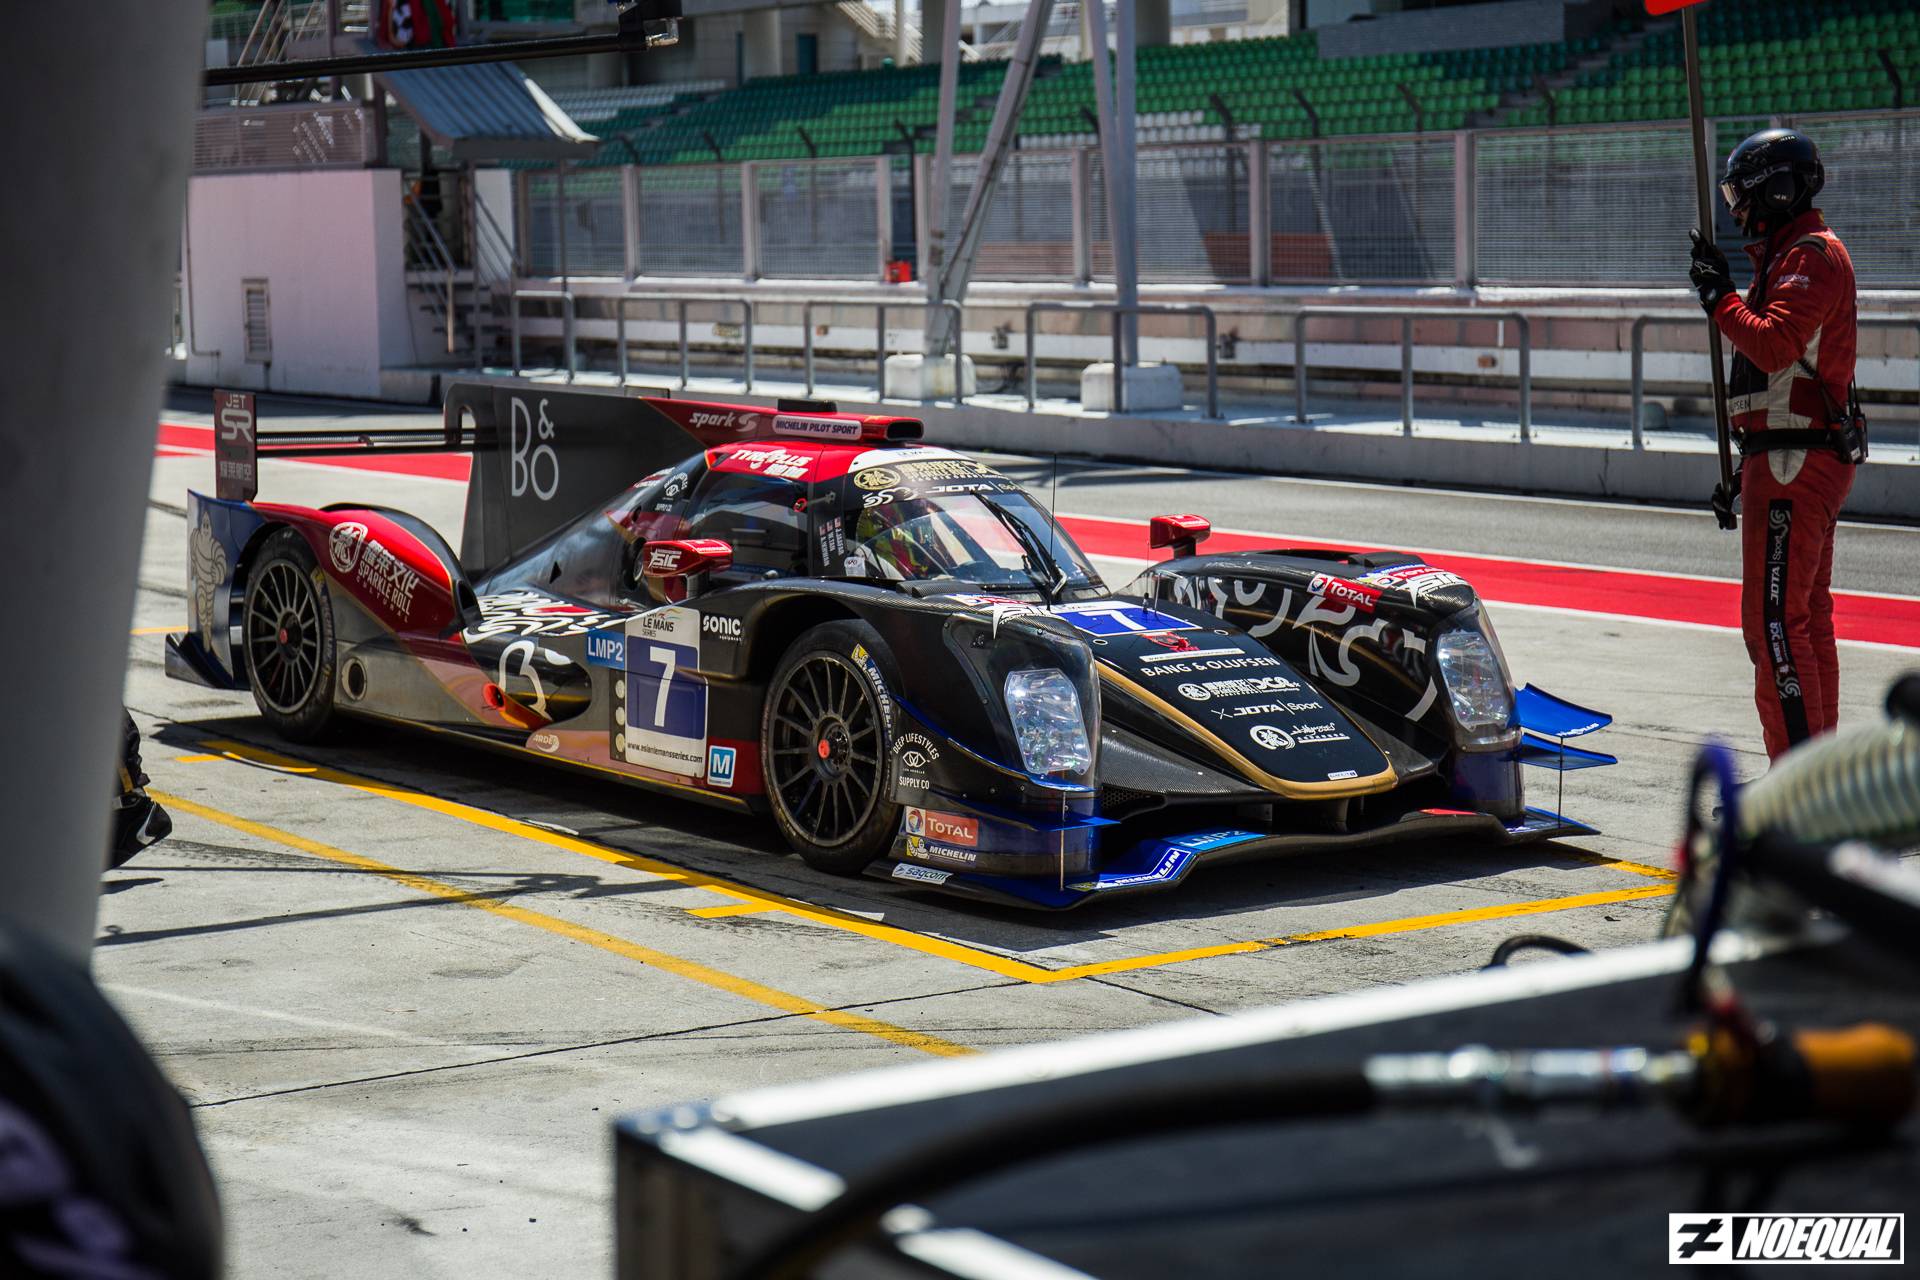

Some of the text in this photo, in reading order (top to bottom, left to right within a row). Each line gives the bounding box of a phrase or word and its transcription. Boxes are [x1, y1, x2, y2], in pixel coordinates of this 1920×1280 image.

[226, 394, 246, 408] JET
[689, 412, 736, 428] spark
[775, 420, 859, 435] MICHELIN PILOT SPORT
[926, 483, 993, 494] JOTA
[358, 560, 411, 615] SPARKLE ROLL
[1330, 581, 1374, 607] TOTAL
[1769, 566, 1781, 605] JOTA
[642, 618, 675, 633] LE MANS
[1079, 609, 1147, 631] 7
[587, 636, 624, 662] LMP2
[1140, 657, 1281, 677] BANG & OLUFSEN
[649, 645, 676, 727] 7
[1233, 704, 1285, 716] JOTA
[1286, 702, 1323, 712] Sport
[892, 732, 940, 761] DEEP LIFESTYLES
[712, 753, 731, 775] M
[898, 775, 930, 790] SUPPLY CO
[927, 817, 974, 839] TOTAL
[929, 845, 977, 862] MICHELIN
